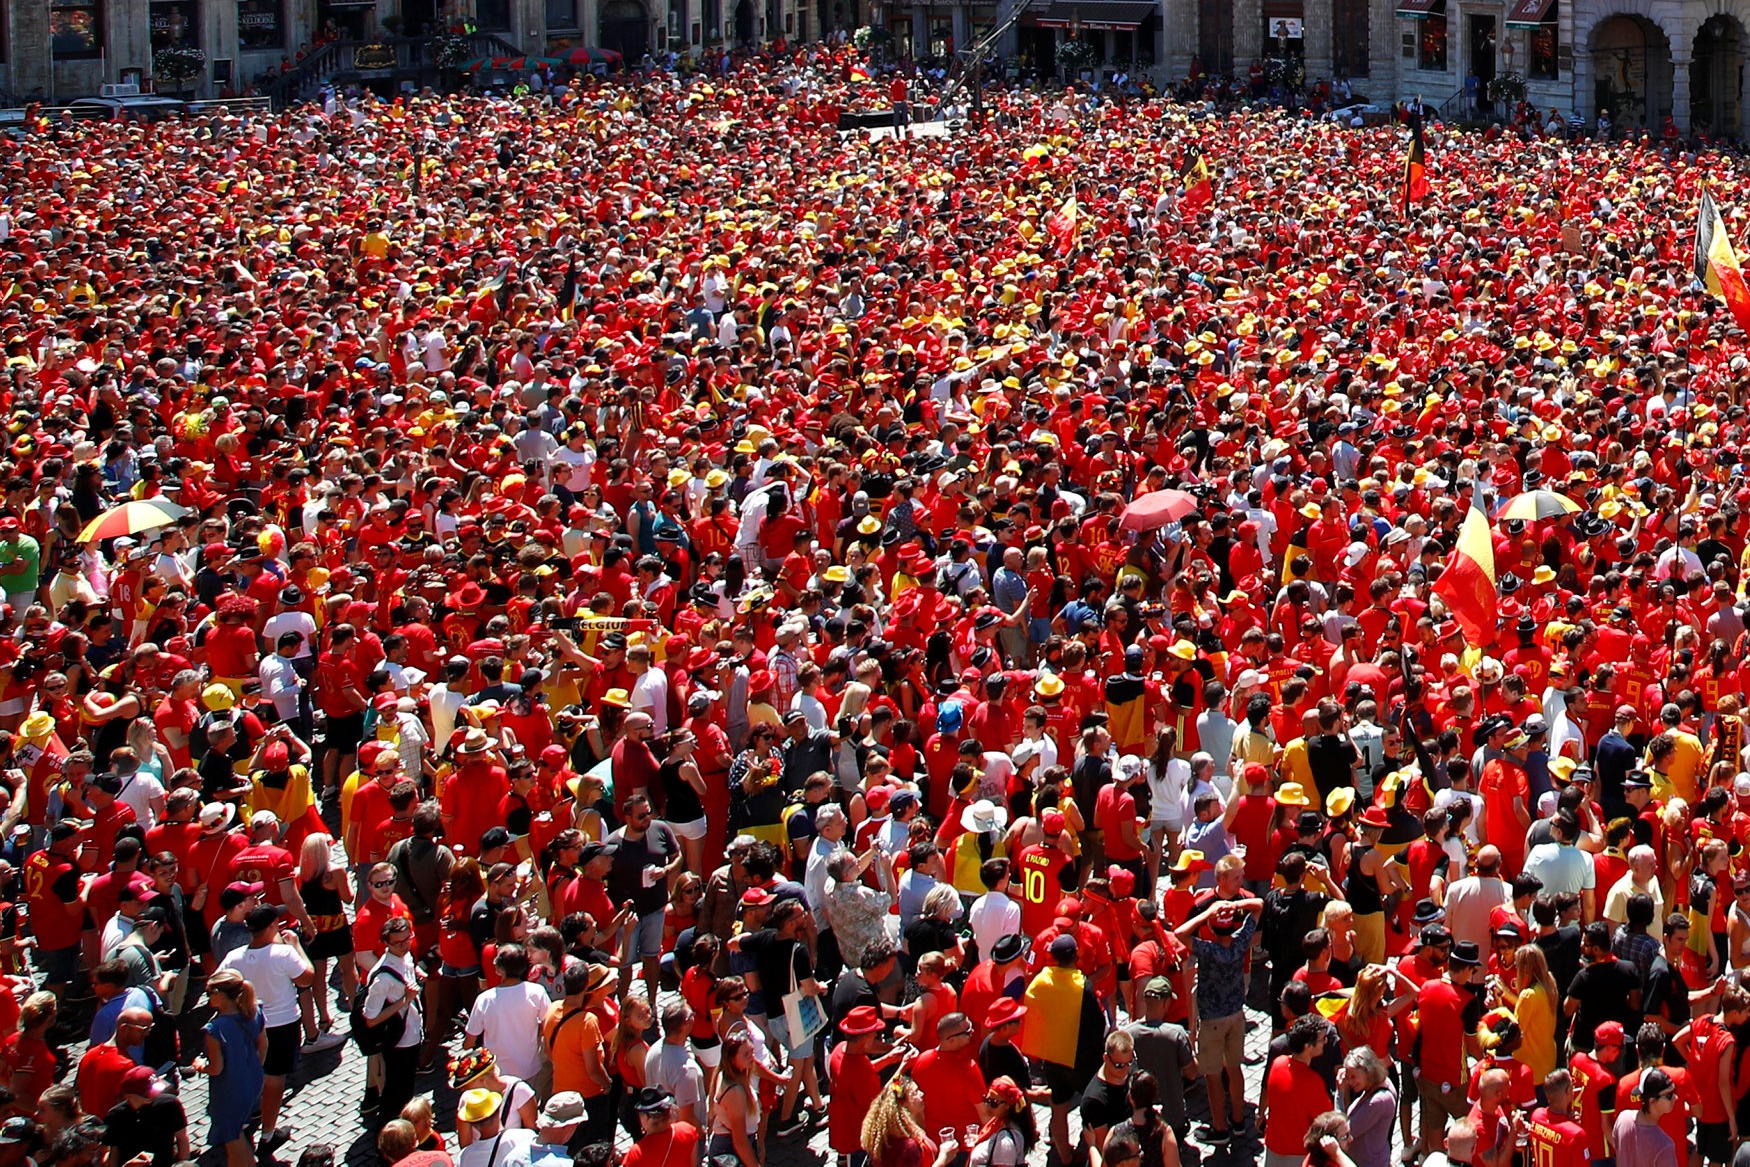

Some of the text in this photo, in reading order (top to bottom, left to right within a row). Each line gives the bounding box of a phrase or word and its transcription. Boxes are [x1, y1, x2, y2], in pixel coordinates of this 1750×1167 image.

[1127, 413, 1141, 433] 14
[1088, 527, 1107, 546] 10
[1099, 547, 1116, 557] MEXICO
[1057, 555, 1071, 576] 12
[573, 620, 631, 631] BELGIUM
[1626, 680, 1642, 709] 9
[1706, 680, 1719, 705] 9
[27, 866, 44, 897] 12
[1024, 869, 1045, 903] 10
